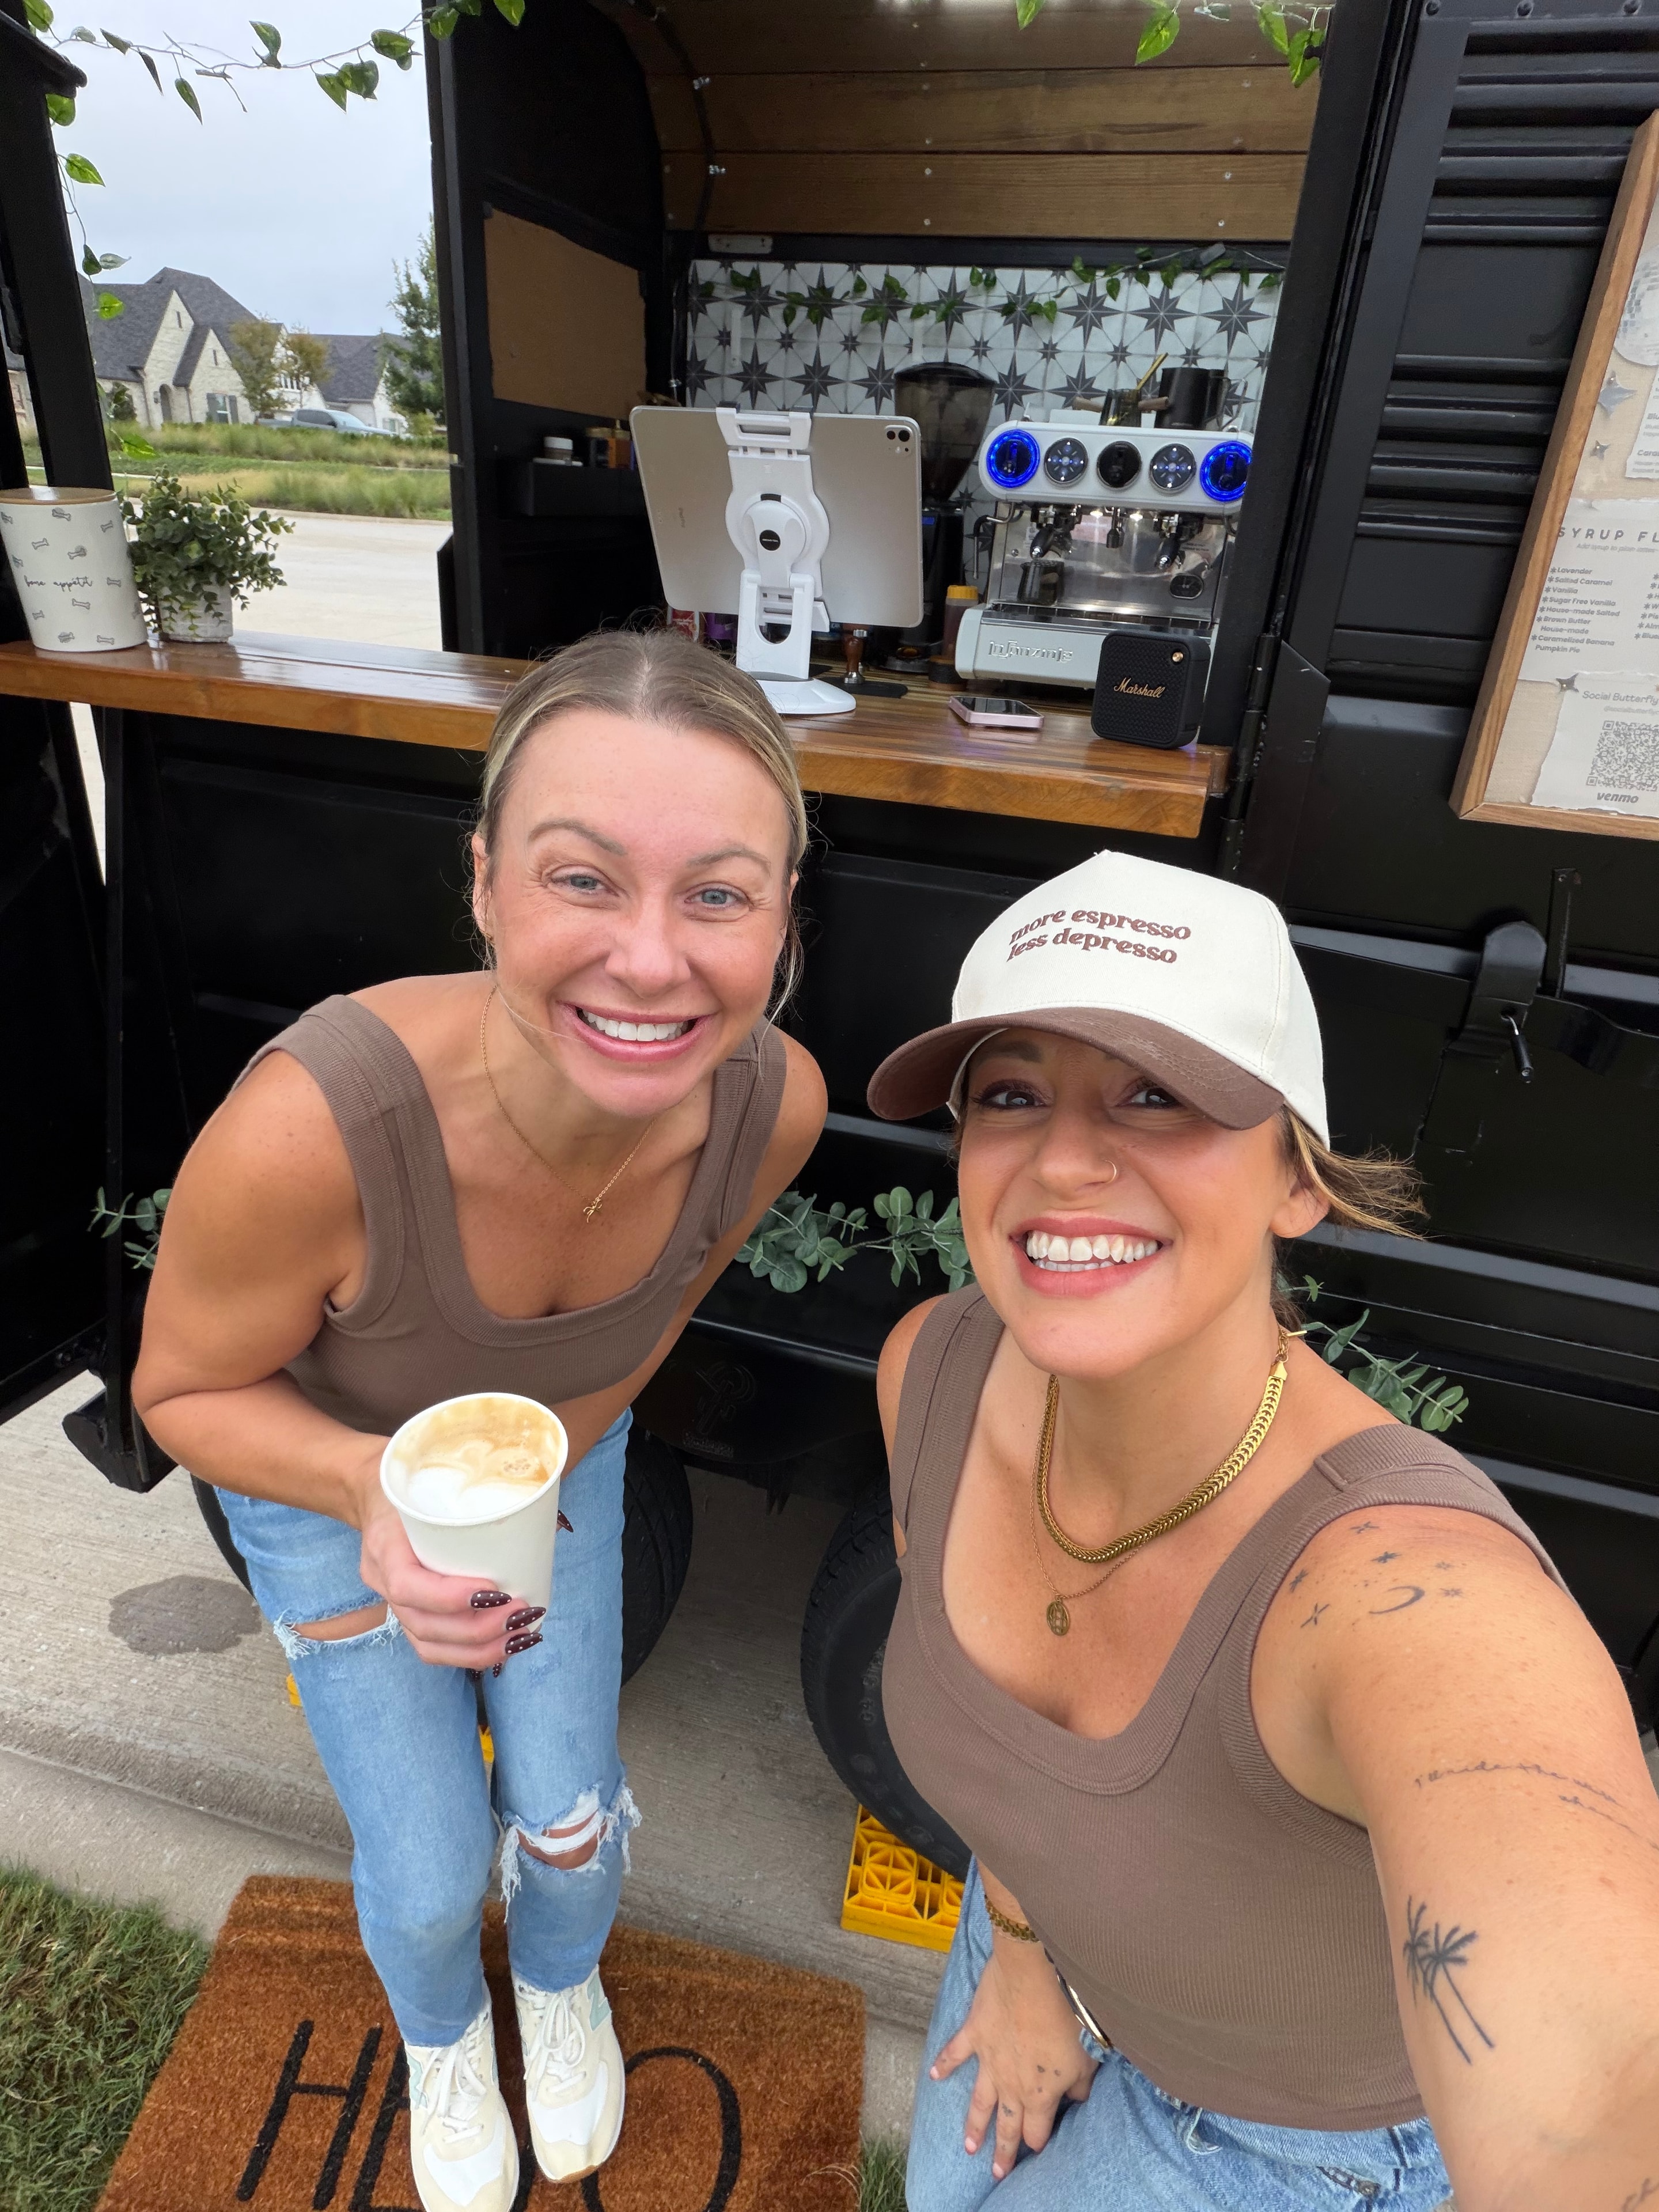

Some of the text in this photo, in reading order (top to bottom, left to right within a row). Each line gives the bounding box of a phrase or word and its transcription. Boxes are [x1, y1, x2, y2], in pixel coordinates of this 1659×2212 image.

[1558, 527, 1624, 540] SYRUP
[1558, 567, 1593, 575] Lavender
[1580, 578, 1613, 586] Caramel
[1549, 596, 1571, 605] Sugar
[1590, 599, 1616, 607] Vanilla
[1546, 606, 1595, 615] House-made
[1540, 625, 1589, 634] House-made
[1538, 635, 1585, 644] Caramelized
[1535, 644, 1567, 653] Pumpkin
[1113, 677, 1166, 698] Marshall
[1582, 690, 1659, 706] Social Butterfly
[1597, 792, 1639, 804] venmo
[1009, 909, 1191, 946] more espresso
[1006, 927, 1177, 964] less depresso
